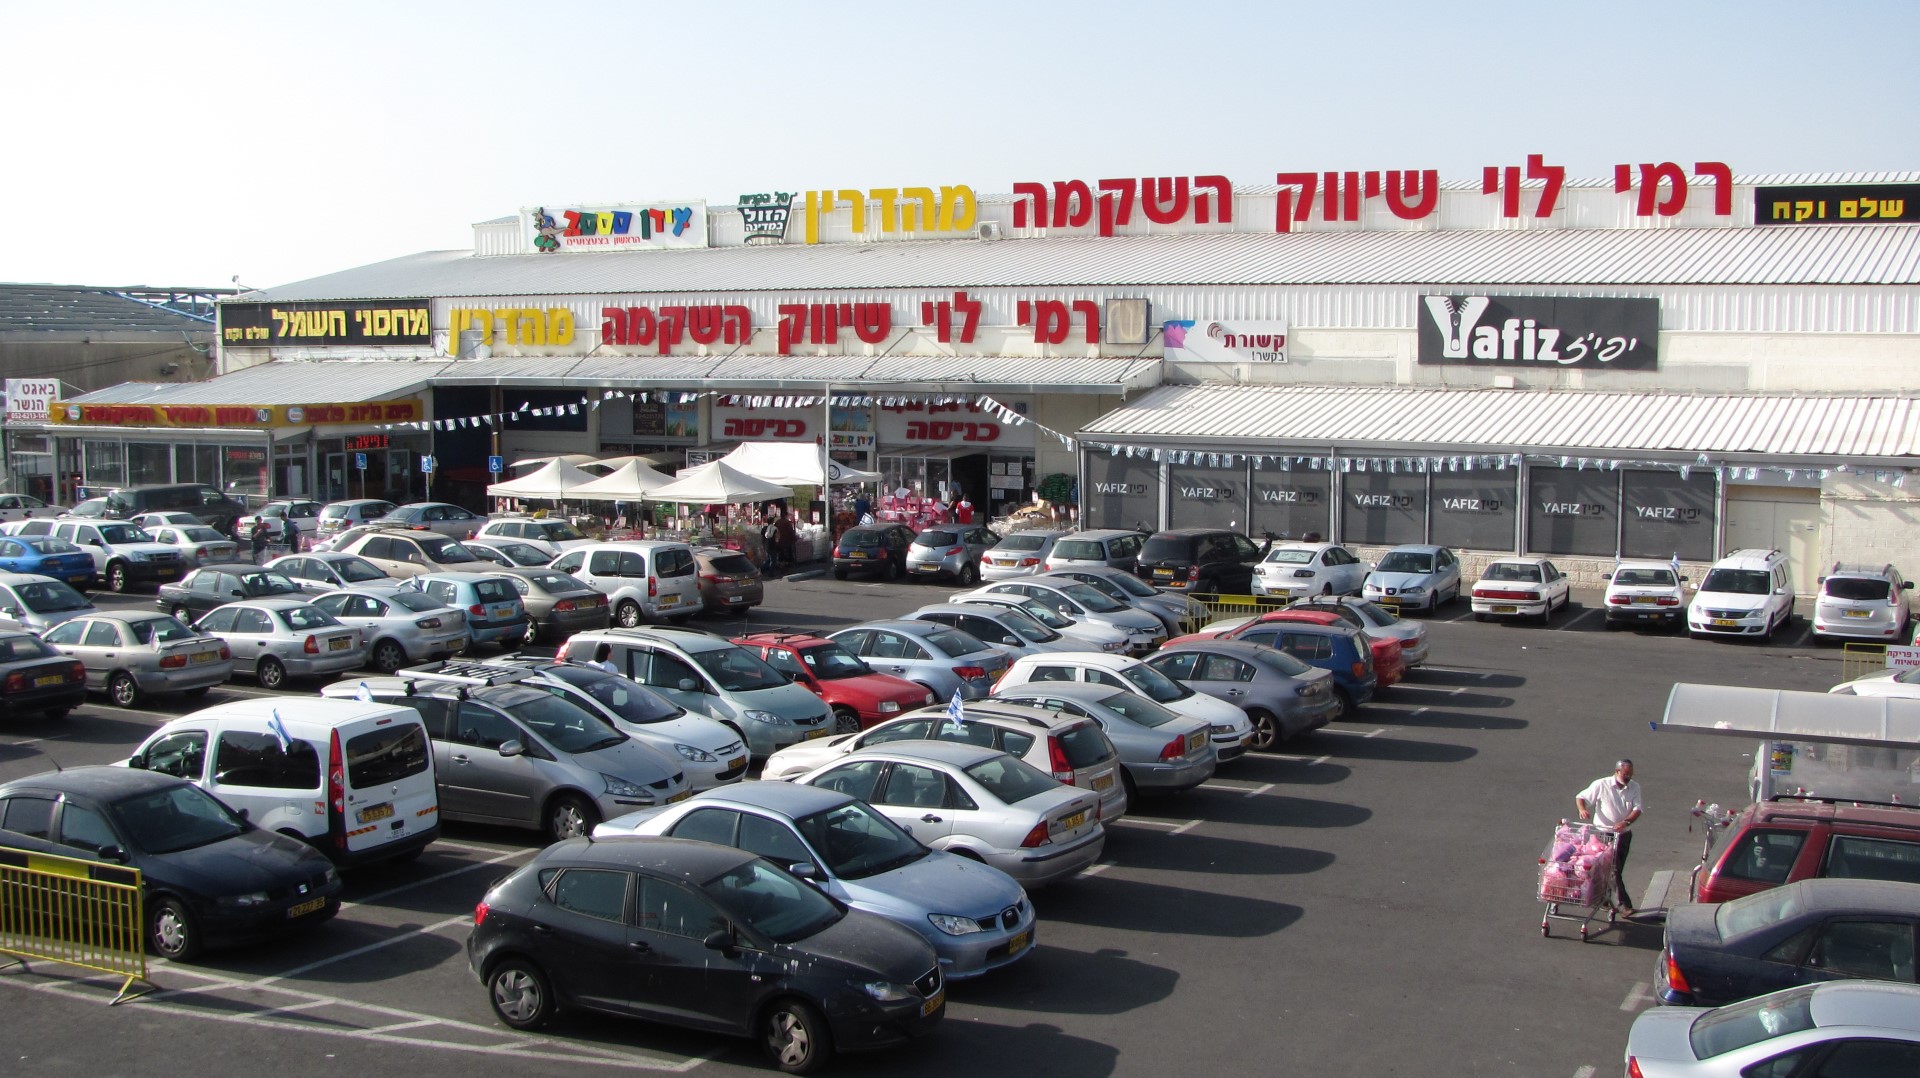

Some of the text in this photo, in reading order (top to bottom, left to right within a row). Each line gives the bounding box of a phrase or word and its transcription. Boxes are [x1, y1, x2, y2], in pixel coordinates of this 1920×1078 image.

[1013, 153, 1732, 237] רמי לוי שיווק השקמה
[743, 208, 787, 222] הזול
[805, 184, 977, 245] מהדרין
[1772, 197, 1904, 222] שלם וקח
[640, 207, 693, 239] עידן
[745, 222, 784, 231] במדינה
[271, 308, 429, 337] מחסני חשמל
[601, 291, 1101, 355] רמי לוי שיווק השקמה
[1425, 295, 1560, 360] Yafiz
[224, 326, 269, 343] שלם וקח
[449, 307, 575, 356] מהדרין
[1223, 332, 1285, 351] קשורת
[22, 384, 56, 395] באגט
[13, 399, 44, 410] הנשר
[724, 418, 806, 437] כניסה
[906, 421, 1000, 442] כניסה
[1095, 482, 1128, 494] YAFIZ
[1181, 486, 1213, 498] YAFIZ
[1262, 490, 1296, 502] YAFIZ
[1355, 494, 1391, 506] YAFIZ
[1442, 498, 1479, 510] YAFIZ
[1542, 502, 1580, 514] YAFIZ
[1636, 506, 1675, 519] YAFIZ
